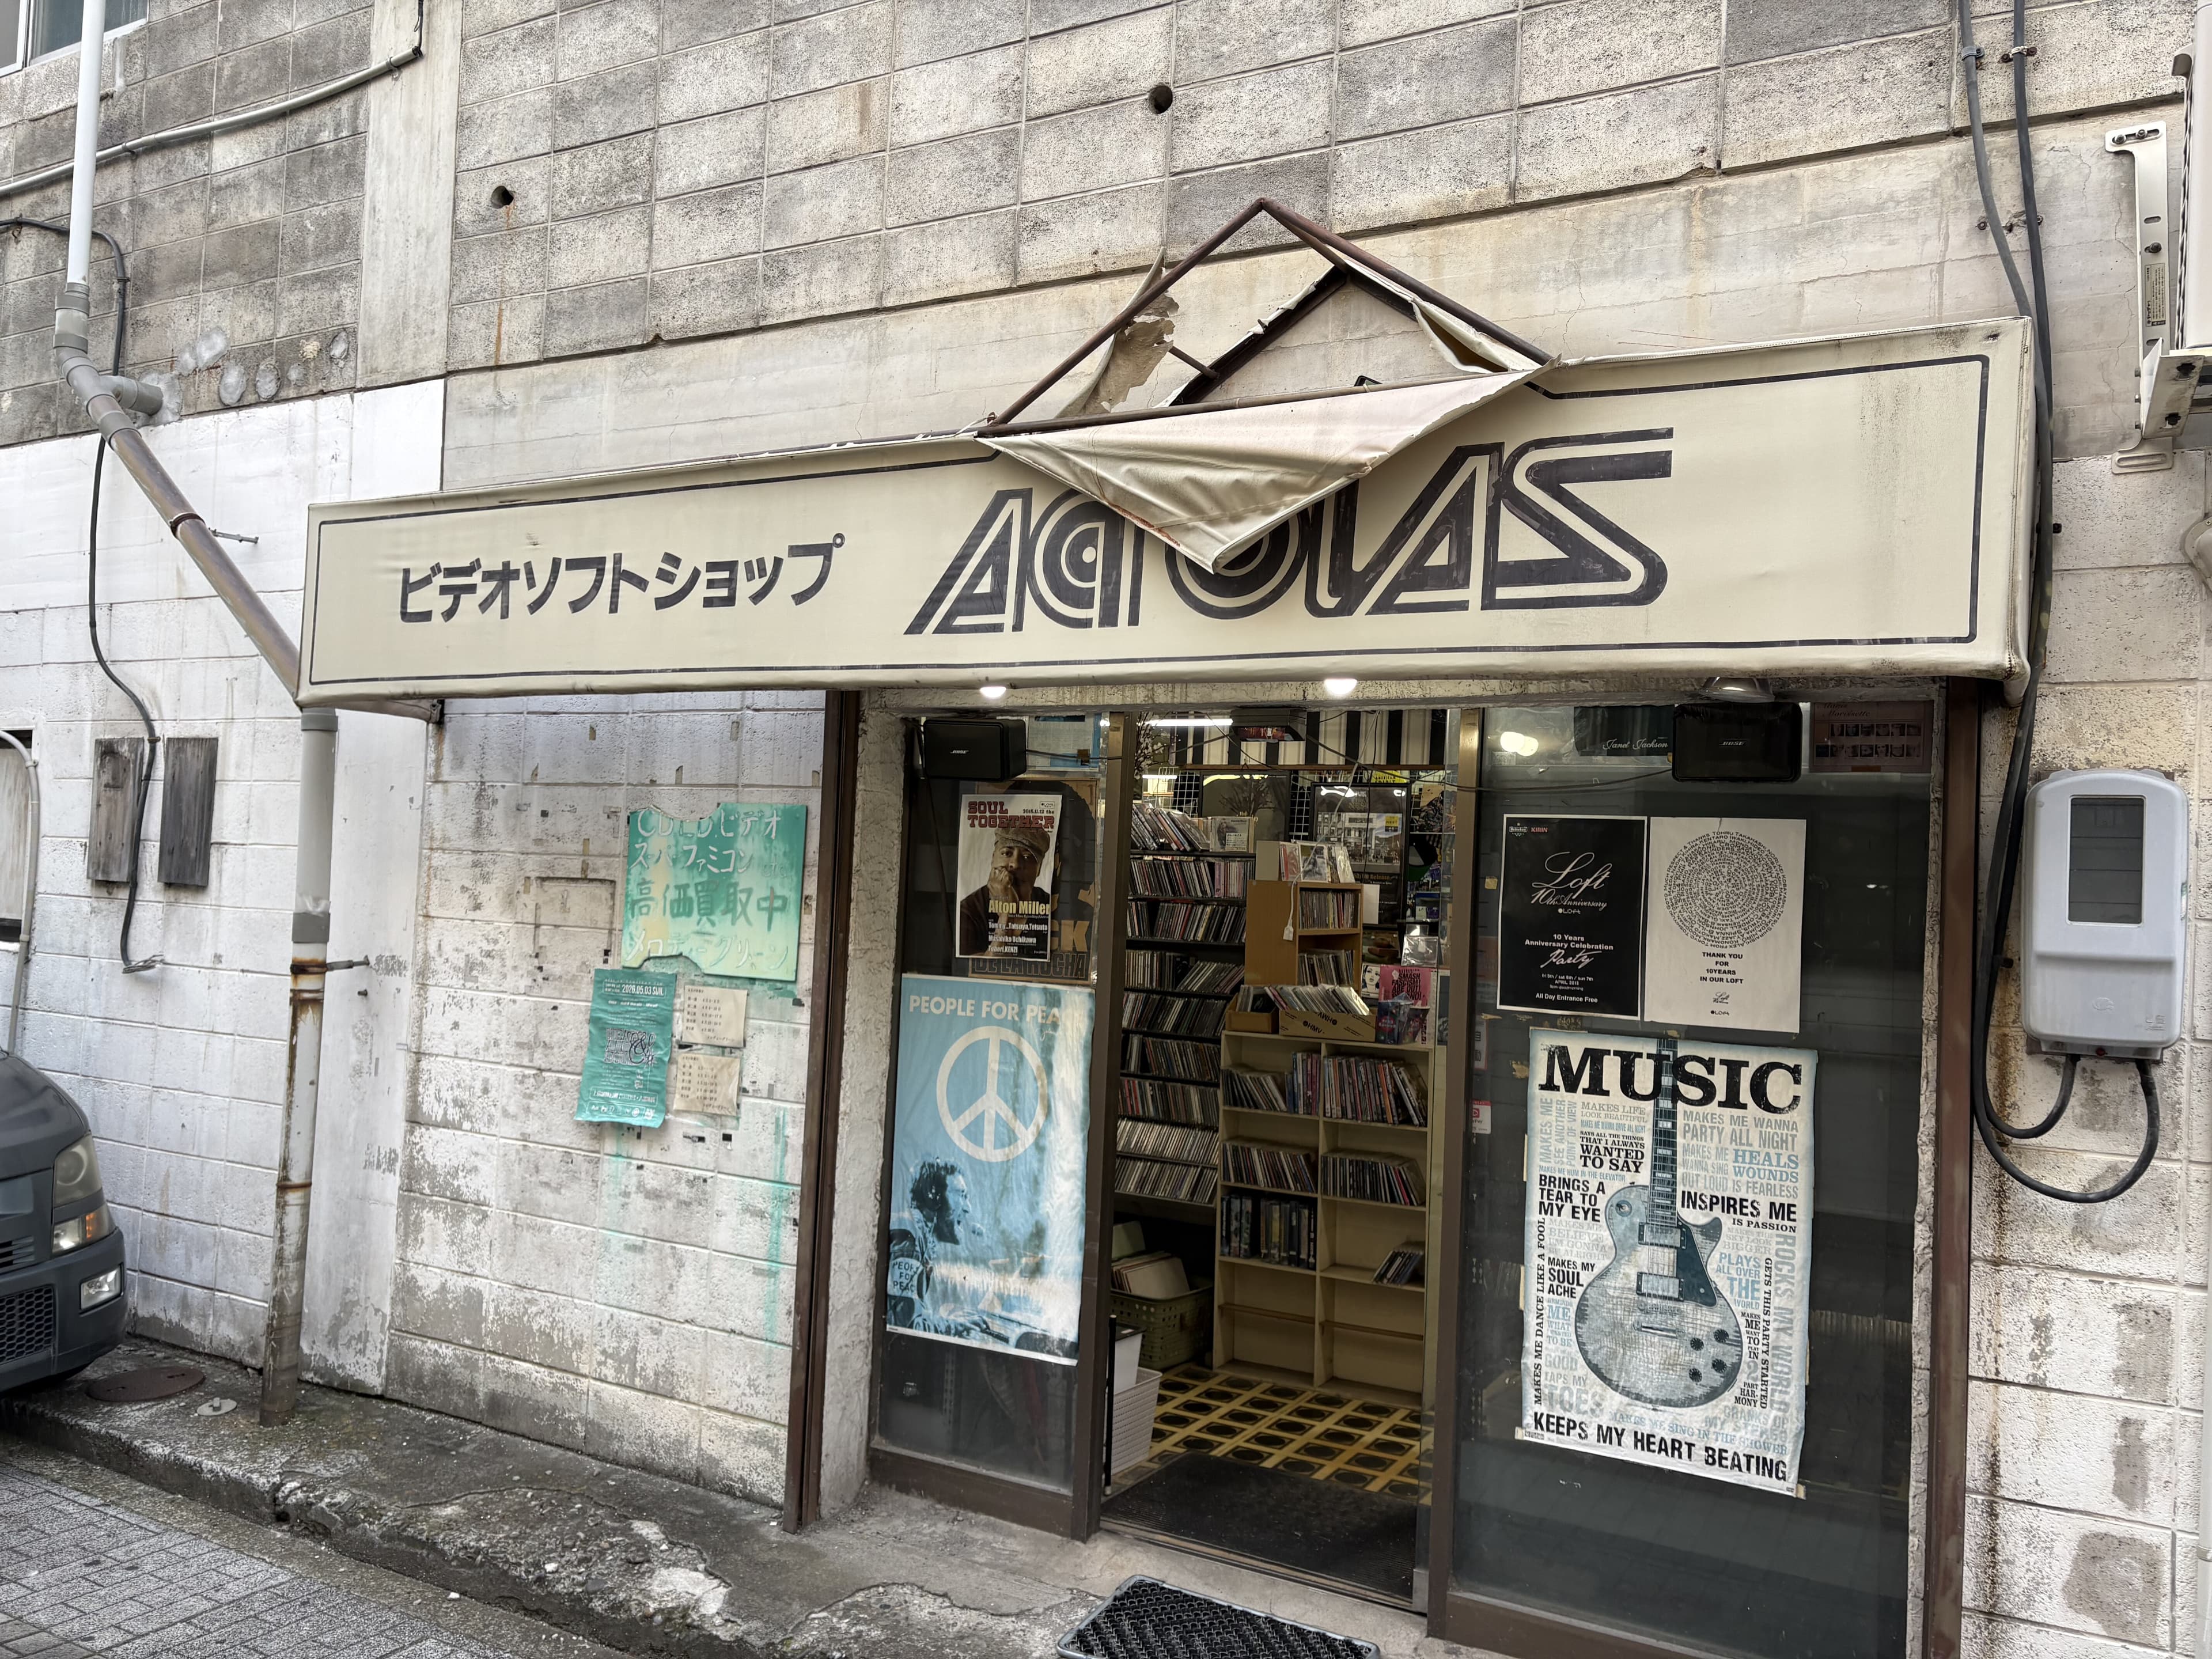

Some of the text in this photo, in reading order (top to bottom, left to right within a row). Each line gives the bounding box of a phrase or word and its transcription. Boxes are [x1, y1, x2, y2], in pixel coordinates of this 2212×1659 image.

[400, 532, 846, 623] ビデオソフトショップ
[1603, 738, 1668, 750] Janet Jackson
[968, 801, 1008, 814] SOUL
[967, 815, 1055, 829] TOGETHER
[1532, 851, 1612, 899] Loft
[630, 877, 789, 932] 高価買取中
[988, 900, 1050, 915] Alton Miller
[1559, 893, 1607, 911] Anniversary
[1525, 939, 1613, 950] Anniversary Celebration
[1540, 948, 1602, 969] Party
[909, 995, 975, 1017] PEOPLE
[981, 1001, 1019, 1021] FOR
[1539, 1045, 1801, 1114] MUSIC
[1581, 1101, 1646, 1115] MAKES LIFE
[1581, 1111, 1647, 1123] LOOK BEAUTIFUL
[1540, 1097, 1553, 1164] MAKES ME
[1683, 1109, 1799, 1133] MAKES ME WANNA
[1554, 1099, 1566, 1165] SEE ANOTHER
[1566, 1101, 1577, 1167] POINT OF VIEW
[1683, 1123, 1798, 1152] PARTY ALL NIGHT
[1580, 1136, 1603, 1145] THAT
[1611, 1140, 1645, 1149] ALWAYS
[1580, 1143, 1645, 1160] WANTED
[1682, 1142, 1729, 1161] MAKES ME
[1580, 1155, 1643, 1173] TO SAY
[1682, 1157, 1729, 1176] WANNA SING
[1733, 1149, 1800, 1171] HEALS
[1539, 1165, 1555, 1173] MAKES
[1558, 1167, 1565, 1175] ME
[1567, 1168, 1579, 1176] HUM
[1588, 1171, 1597, 1179] THE
[1599, 1172, 1626, 1182] ELEVATOR
[1681, 1171, 1728, 1192] OUT LOUD
[1733, 1165, 1800, 1184] WOUNDS
[1539, 1174, 1605, 1195] BRINGS A
[1732, 1179, 1799, 1199] IS FEARLESS
[1539, 1187, 1597, 1207] TEAR TO
[1681, 1190, 1797, 1222] INSPIRES ME
[1539, 1200, 1601, 1223] MY EYE
[1537, 1217, 1546, 1250] FOOL
[1732, 1218, 1797, 1233] IS PASSION
[1537, 1253, 1545, 1262] A
[1548, 1256, 1596, 1272] MAKES MY
[1718, 1252, 1761, 1269] PLAYS
[1548, 1267, 1584, 1287] SOUL
[1715, 1264, 1760, 1279] ALL OVER
[1547, 1283, 1577, 1299] ACHE
[1726, 1276, 1761, 1301] THE
[1734, 1298, 1760, 1310] WORLD
[1535, 1296, 1544, 1339] DANCE
[1741, 1311, 1761, 1320] MAKES
[1745, 1319, 1761, 1330] ME
[1770, 1233, 1797, 1412] ROCKS MY WORLD
[1547, 1335, 1573, 1347] TO BE
[1747, 1336, 1760, 1346] TO
[1760, 1257, 1772, 1409] GETS THIS PARTY STARTED
[1535, 1340, 1543, 1360] ME
[1748, 1351, 1759, 1360] IN
[1544, 1353, 1579, 1372] GOOD
[1747, 1360, 1758, 1382] 2
[1533, 1363, 1542, 1406] MAKES
[1544, 1371, 1589, 1388] TAPS MY
[1743, 1381, 1759, 1390] PART
[1544, 1384, 1605, 1418] TOES
[1734, 1396, 1758, 1408] MONY
[1533, 1411, 1589, 1441] KEEPS
[1596, 1423, 1626, 1447] MY
[1633, 1430, 1696, 1463] HEART
[1704, 1446, 1787, 1483] BEATING
